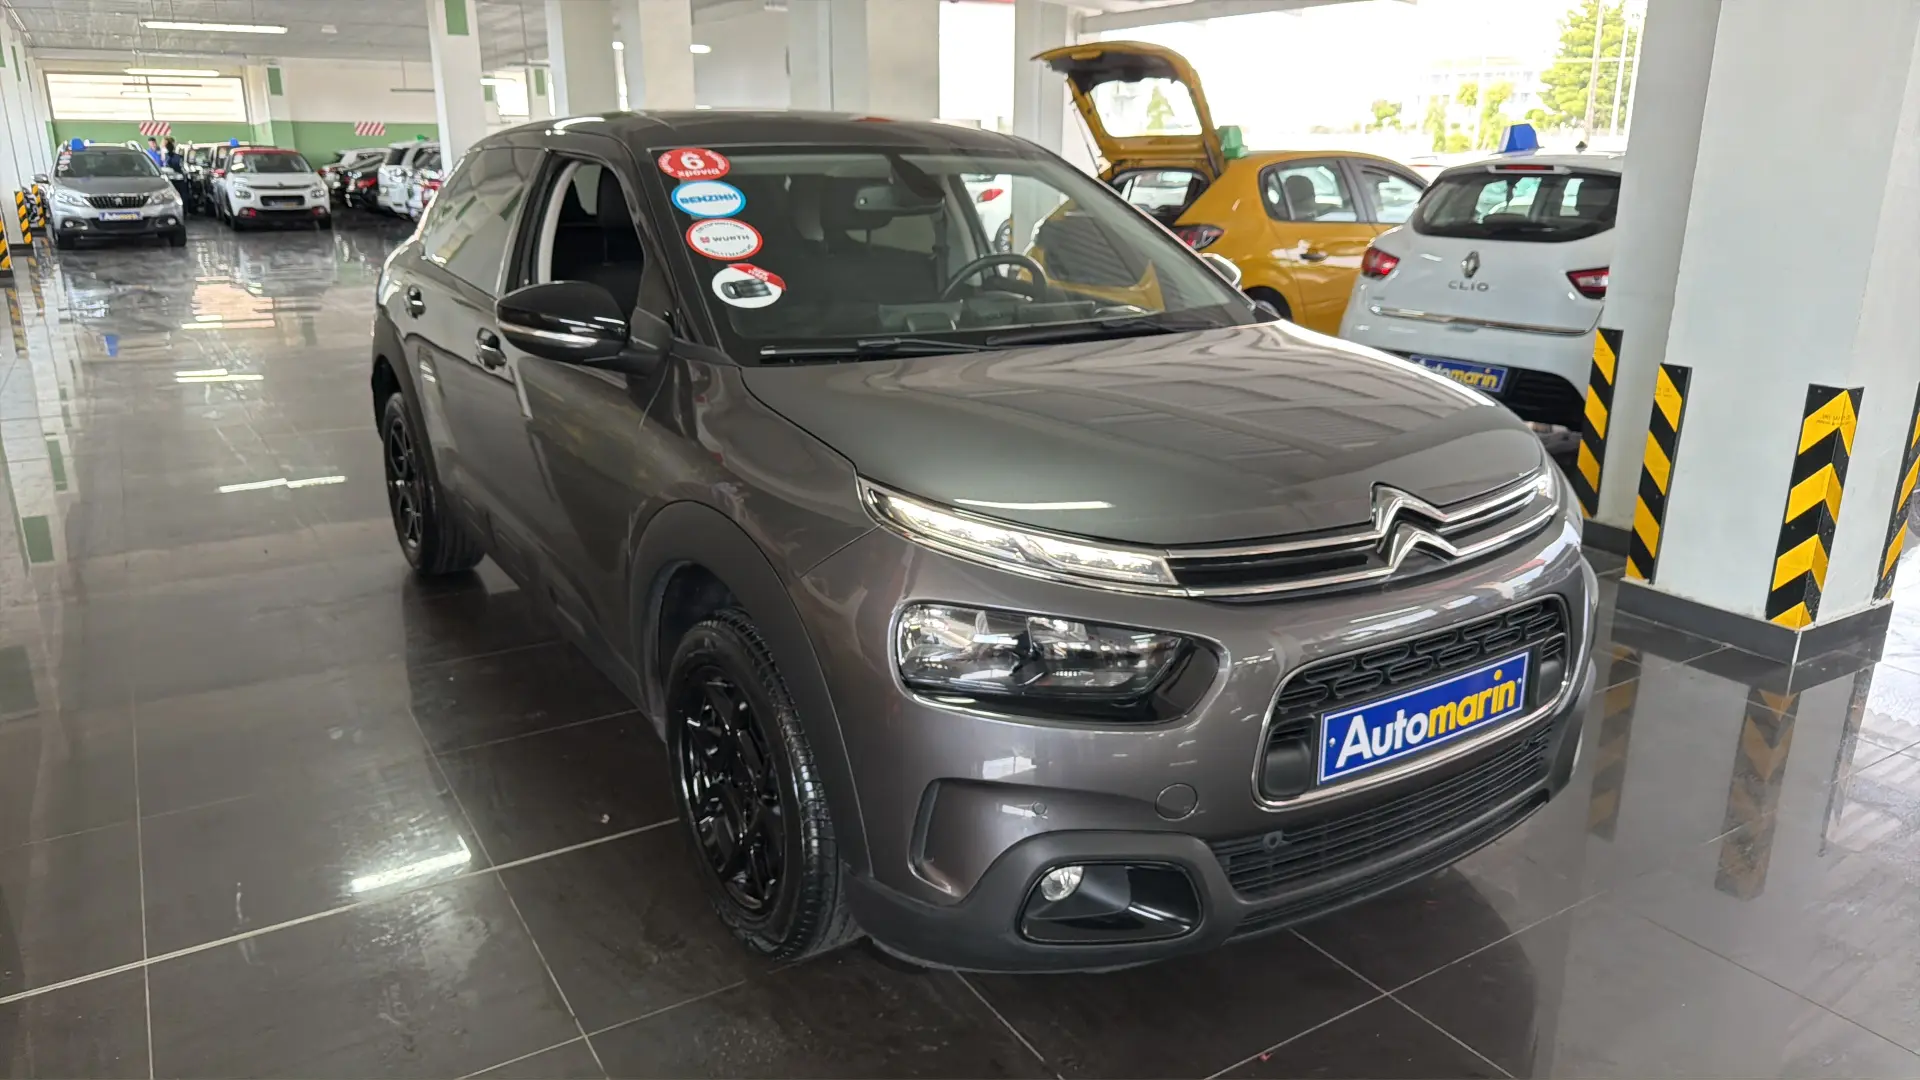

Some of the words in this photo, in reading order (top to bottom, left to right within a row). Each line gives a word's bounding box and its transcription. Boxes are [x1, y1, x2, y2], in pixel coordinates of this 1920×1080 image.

[680, 151, 705, 170] 6
[1447, 280, 1490, 292] CLIO
[1419, 358, 1498, 389] tomarin
[1335, 669, 1516, 769] Automarin
